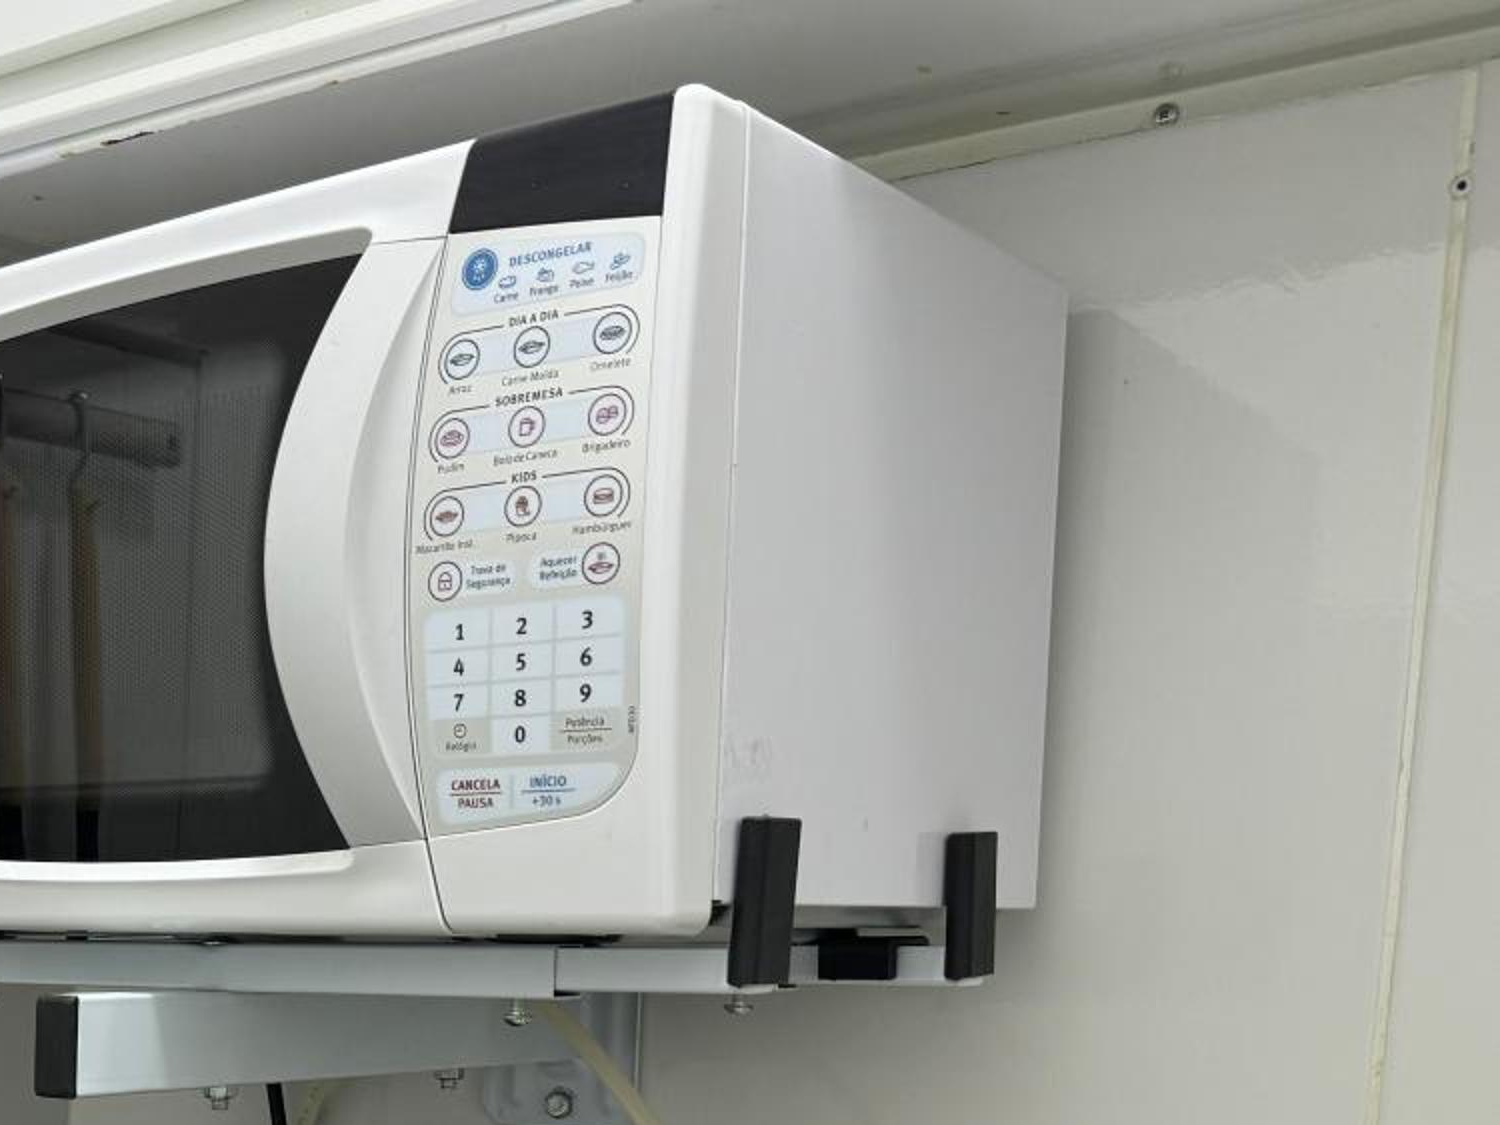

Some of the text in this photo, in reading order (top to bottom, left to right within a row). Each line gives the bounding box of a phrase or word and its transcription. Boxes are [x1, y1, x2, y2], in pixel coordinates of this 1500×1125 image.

[509, 241, 592, 267] DESCONGELAR
[509, 309, 559, 327] DIA A DIA
[495, 386, 563, 407] SOBREMESA
[582, 439, 631, 454] Brigadeiro
[511, 471, 537, 483] KIDS
[516, 617, 527, 635] 2
[581, 610, 593, 629] 3
[455, 623, 464, 640] 1
[516, 652, 526, 671] 5
[580, 647, 592, 666] 6
[453, 658, 464, 676] 4
[514, 689, 527, 707] 8
[580, 683, 591, 702] 9
[453, 693, 464, 712] 7
[514, 726, 526, 743] 0
[451, 779, 500, 791] CANCELA
[530, 775, 567, 787] INÍCIO
[458, 797, 493, 809] PAUSA
